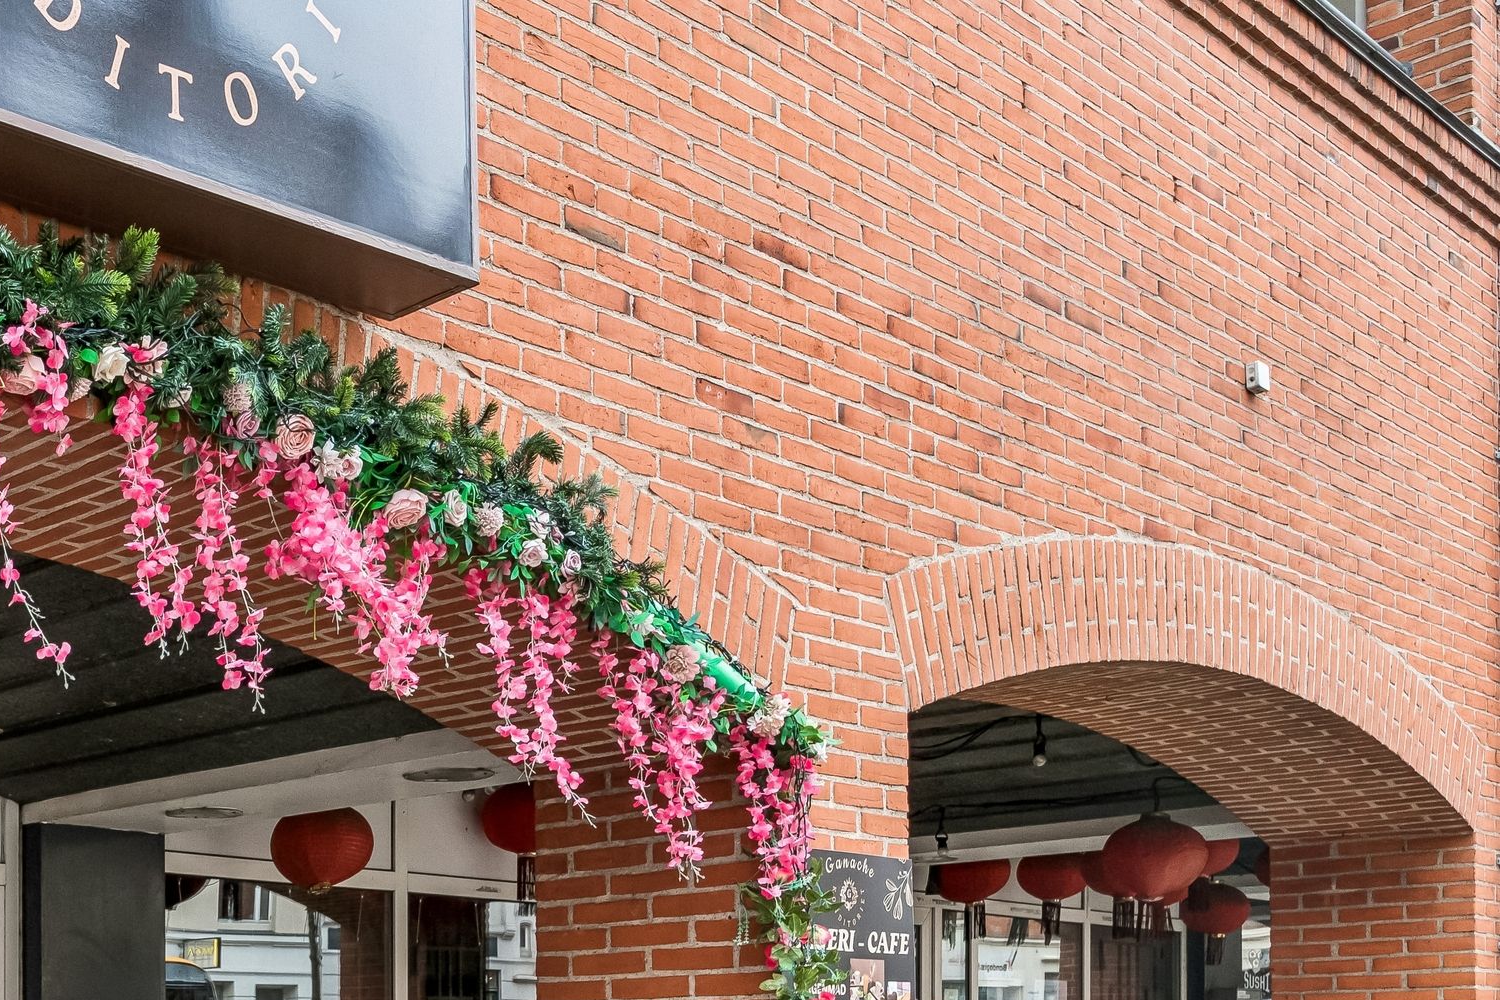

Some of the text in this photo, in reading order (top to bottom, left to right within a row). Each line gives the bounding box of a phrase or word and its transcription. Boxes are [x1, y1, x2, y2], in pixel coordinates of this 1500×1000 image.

[825, 857, 875, 878] Ganache
[867, 931, 910, 955] CAFE
[1243, 971, 1271, 992] SUSHI
